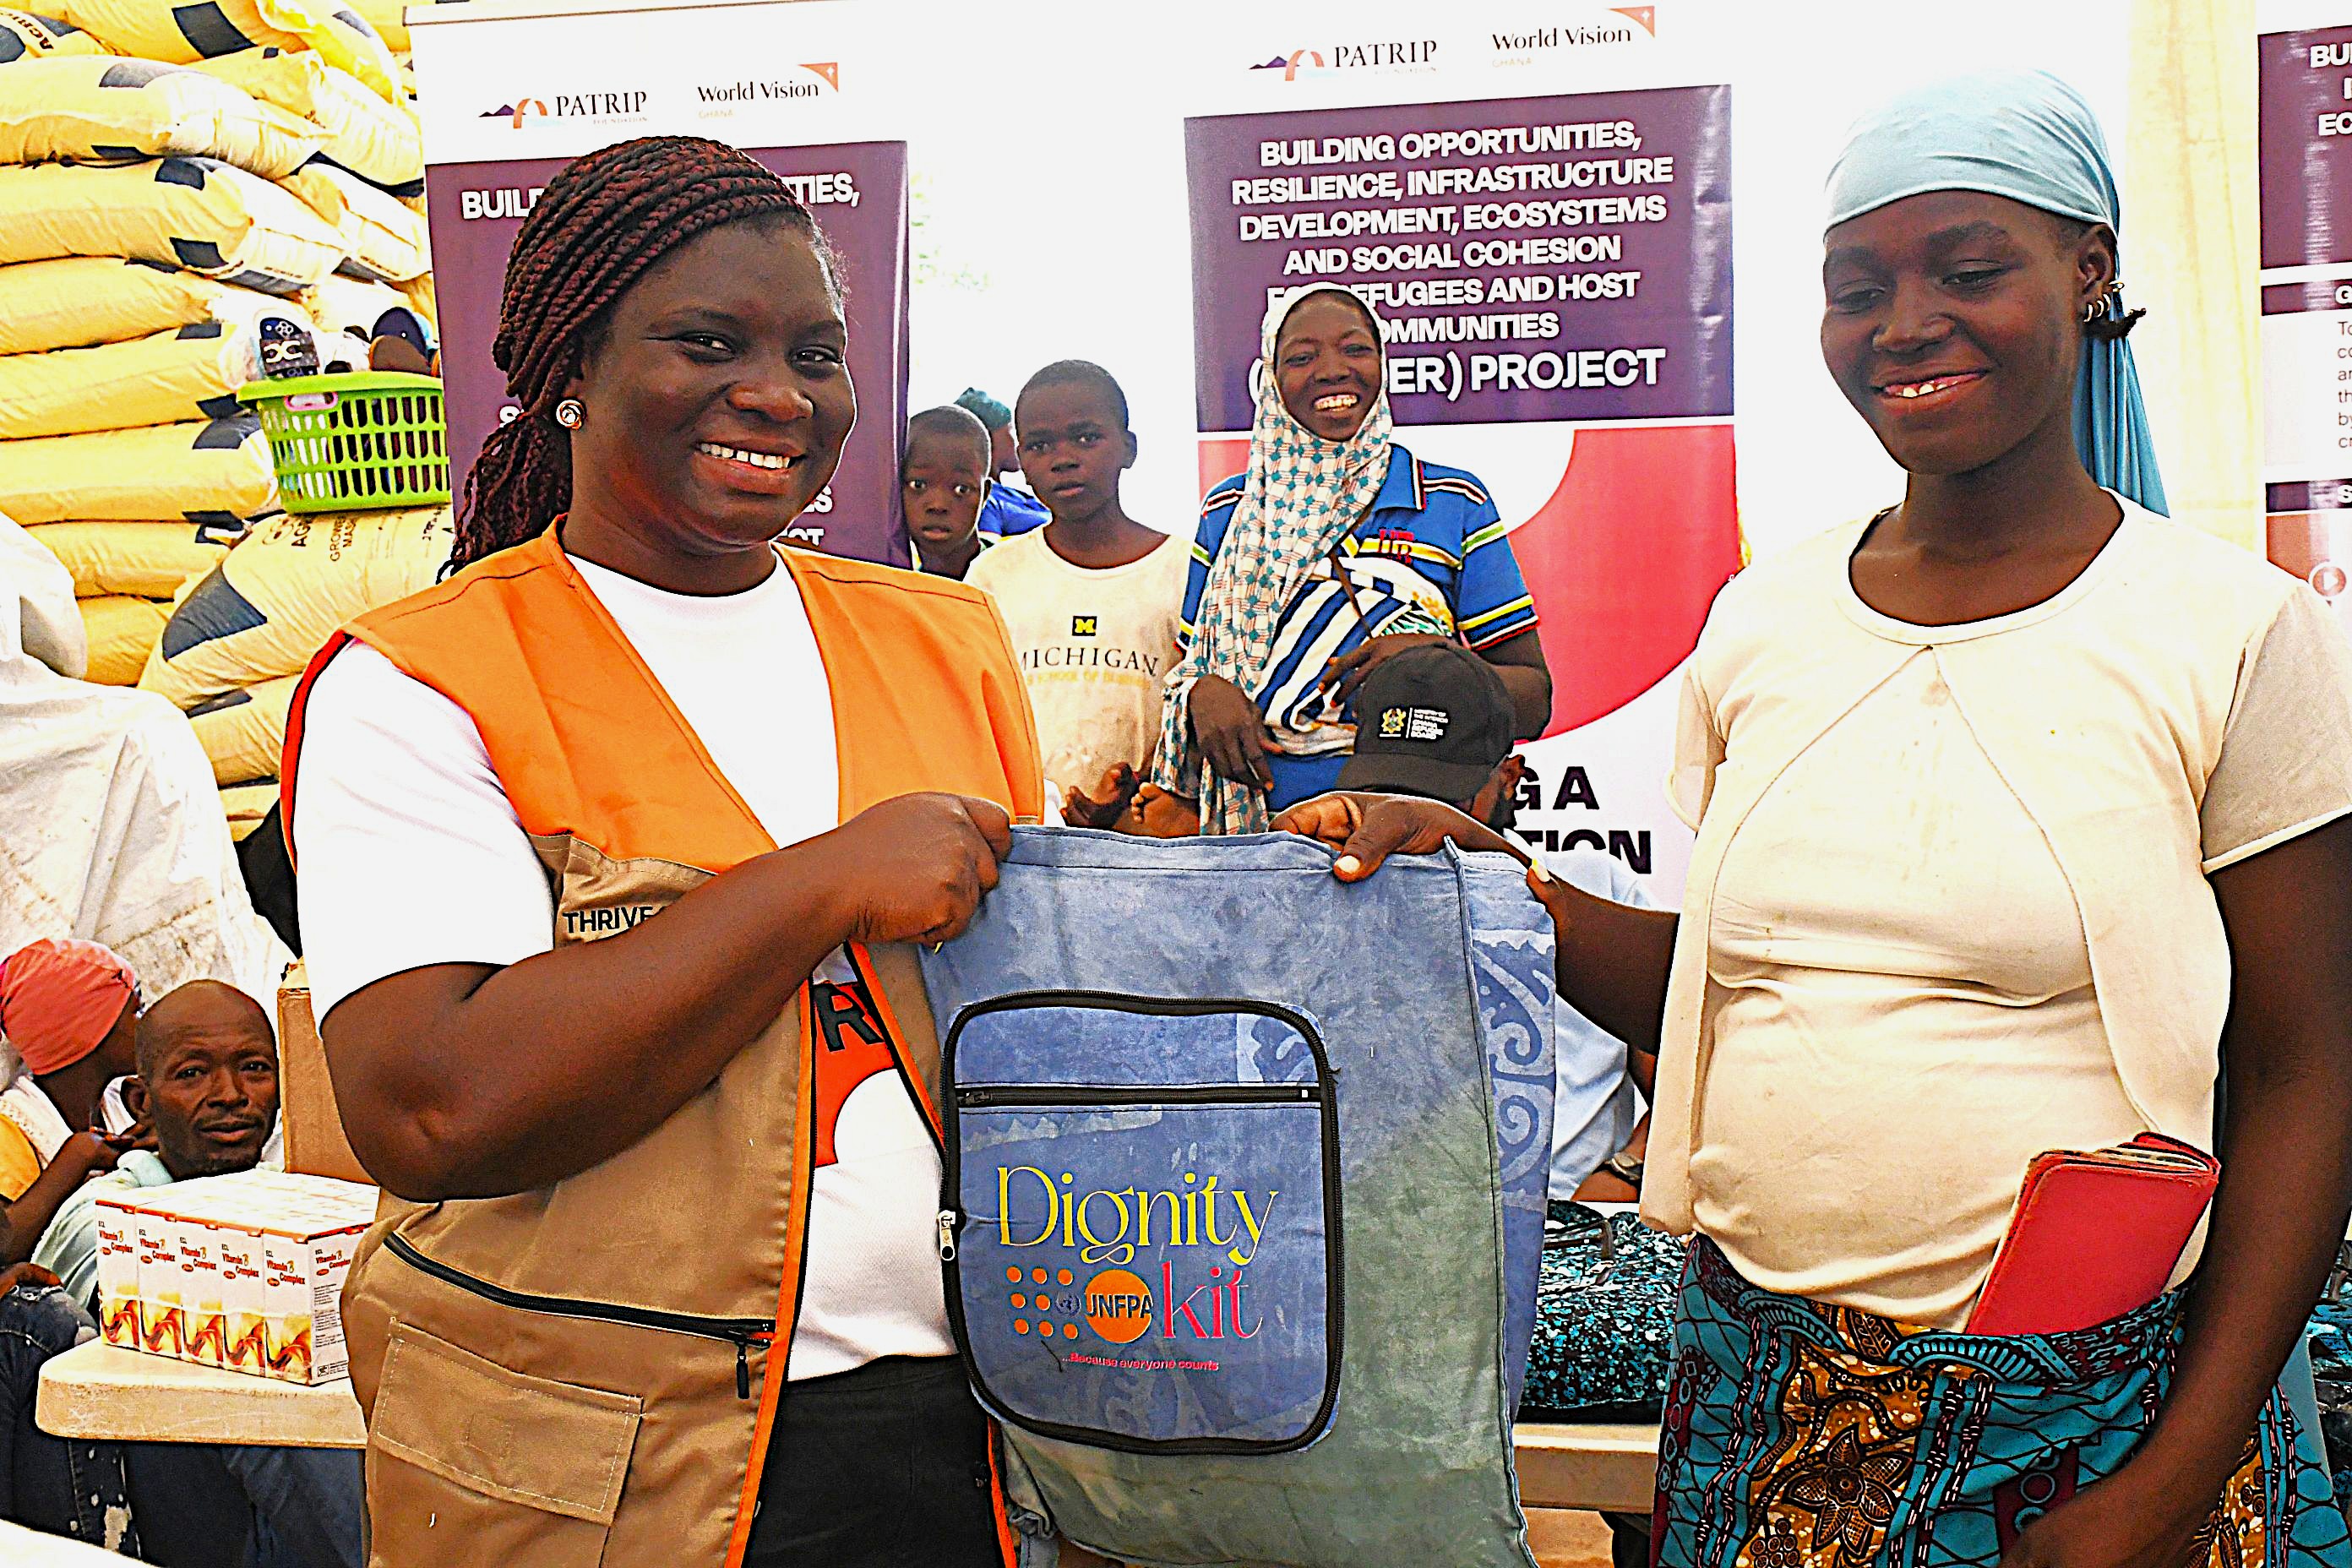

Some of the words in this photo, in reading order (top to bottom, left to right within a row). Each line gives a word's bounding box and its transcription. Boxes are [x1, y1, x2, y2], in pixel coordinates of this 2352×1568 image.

[1492, 28, 1558, 51] World
[1565, 26, 1631, 45] Vision
[1335, 40, 1437, 68] PATRIP
[556, 90, 648, 117] PATRIP
[698, 82, 754, 102] World
[761, 79, 819, 99] Vision
[1260, 134, 1395, 167] BUILDING
[1399, 120, 1642, 161] OPPORTUNITIES,
[779, 172, 860, 208] TIES,
[1232, 172, 1403, 204] RESILIENCE,
[1407, 157, 1674, 198] INFRASTRUCTURE
[1239, 205, 1459, 241] DEVELOPMENT,
[1462, 195, 1667, 231] ECOSYSTEMS
[1283, 248, 1349, 275] AND
[1352, 242, 1460, 272] SOCIAL
[1463, 235, 1620, 268] COHESION
[1348, 278, 1484, 309] EFUGEES
[1488, 275, 1554, 303] AND
[1558, 271, 1641, 300] HOST
[1380, 313, 1560, 343] OMMUNITIES
[1472, 349, 1667, 394] PROJECT
[1074, 618, 1097, 634] M
[1552, 765, 1600, 810] A
[997, 1166, 1279, 1266] Dignity
[111, 1242, 133, 1254] Complex
[152, 1250, 176, 1262] Complex
[193, 1259, 217, 1271] Complex
[236, 1266, 259, 1278] Complex
[329, 1259, 351, 1269] Complex
[280, 1272, 305, 1285] Complex
[1162, 1260, 1263, 1339] kit
[1119, 1358, 1176, 1370] everyone
[1179, 1359, 1219, 1371] counts
